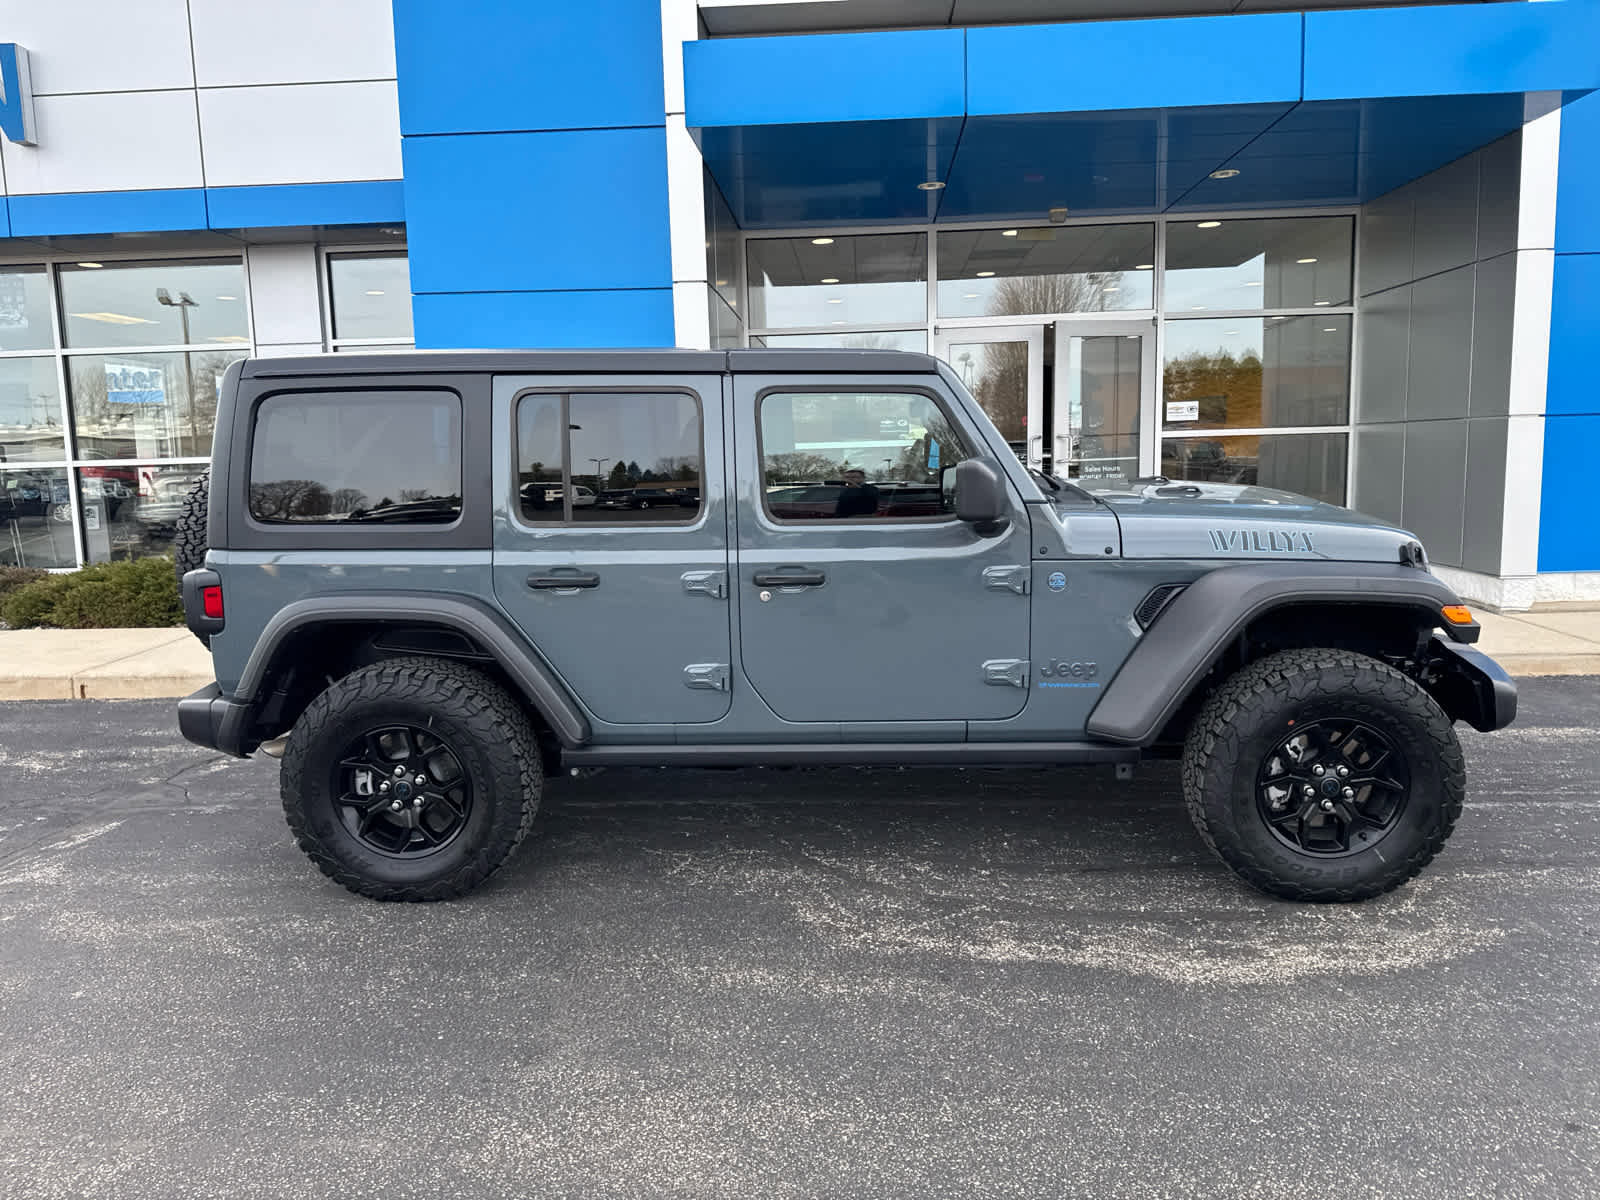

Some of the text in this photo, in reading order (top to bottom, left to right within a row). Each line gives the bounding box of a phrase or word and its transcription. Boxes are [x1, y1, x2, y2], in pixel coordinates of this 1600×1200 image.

[1085, 465, 1101, 473] Sales
[1208, 529, 1313, 552] WILLYS
[1040, 658, 1097, 681] Jeep
